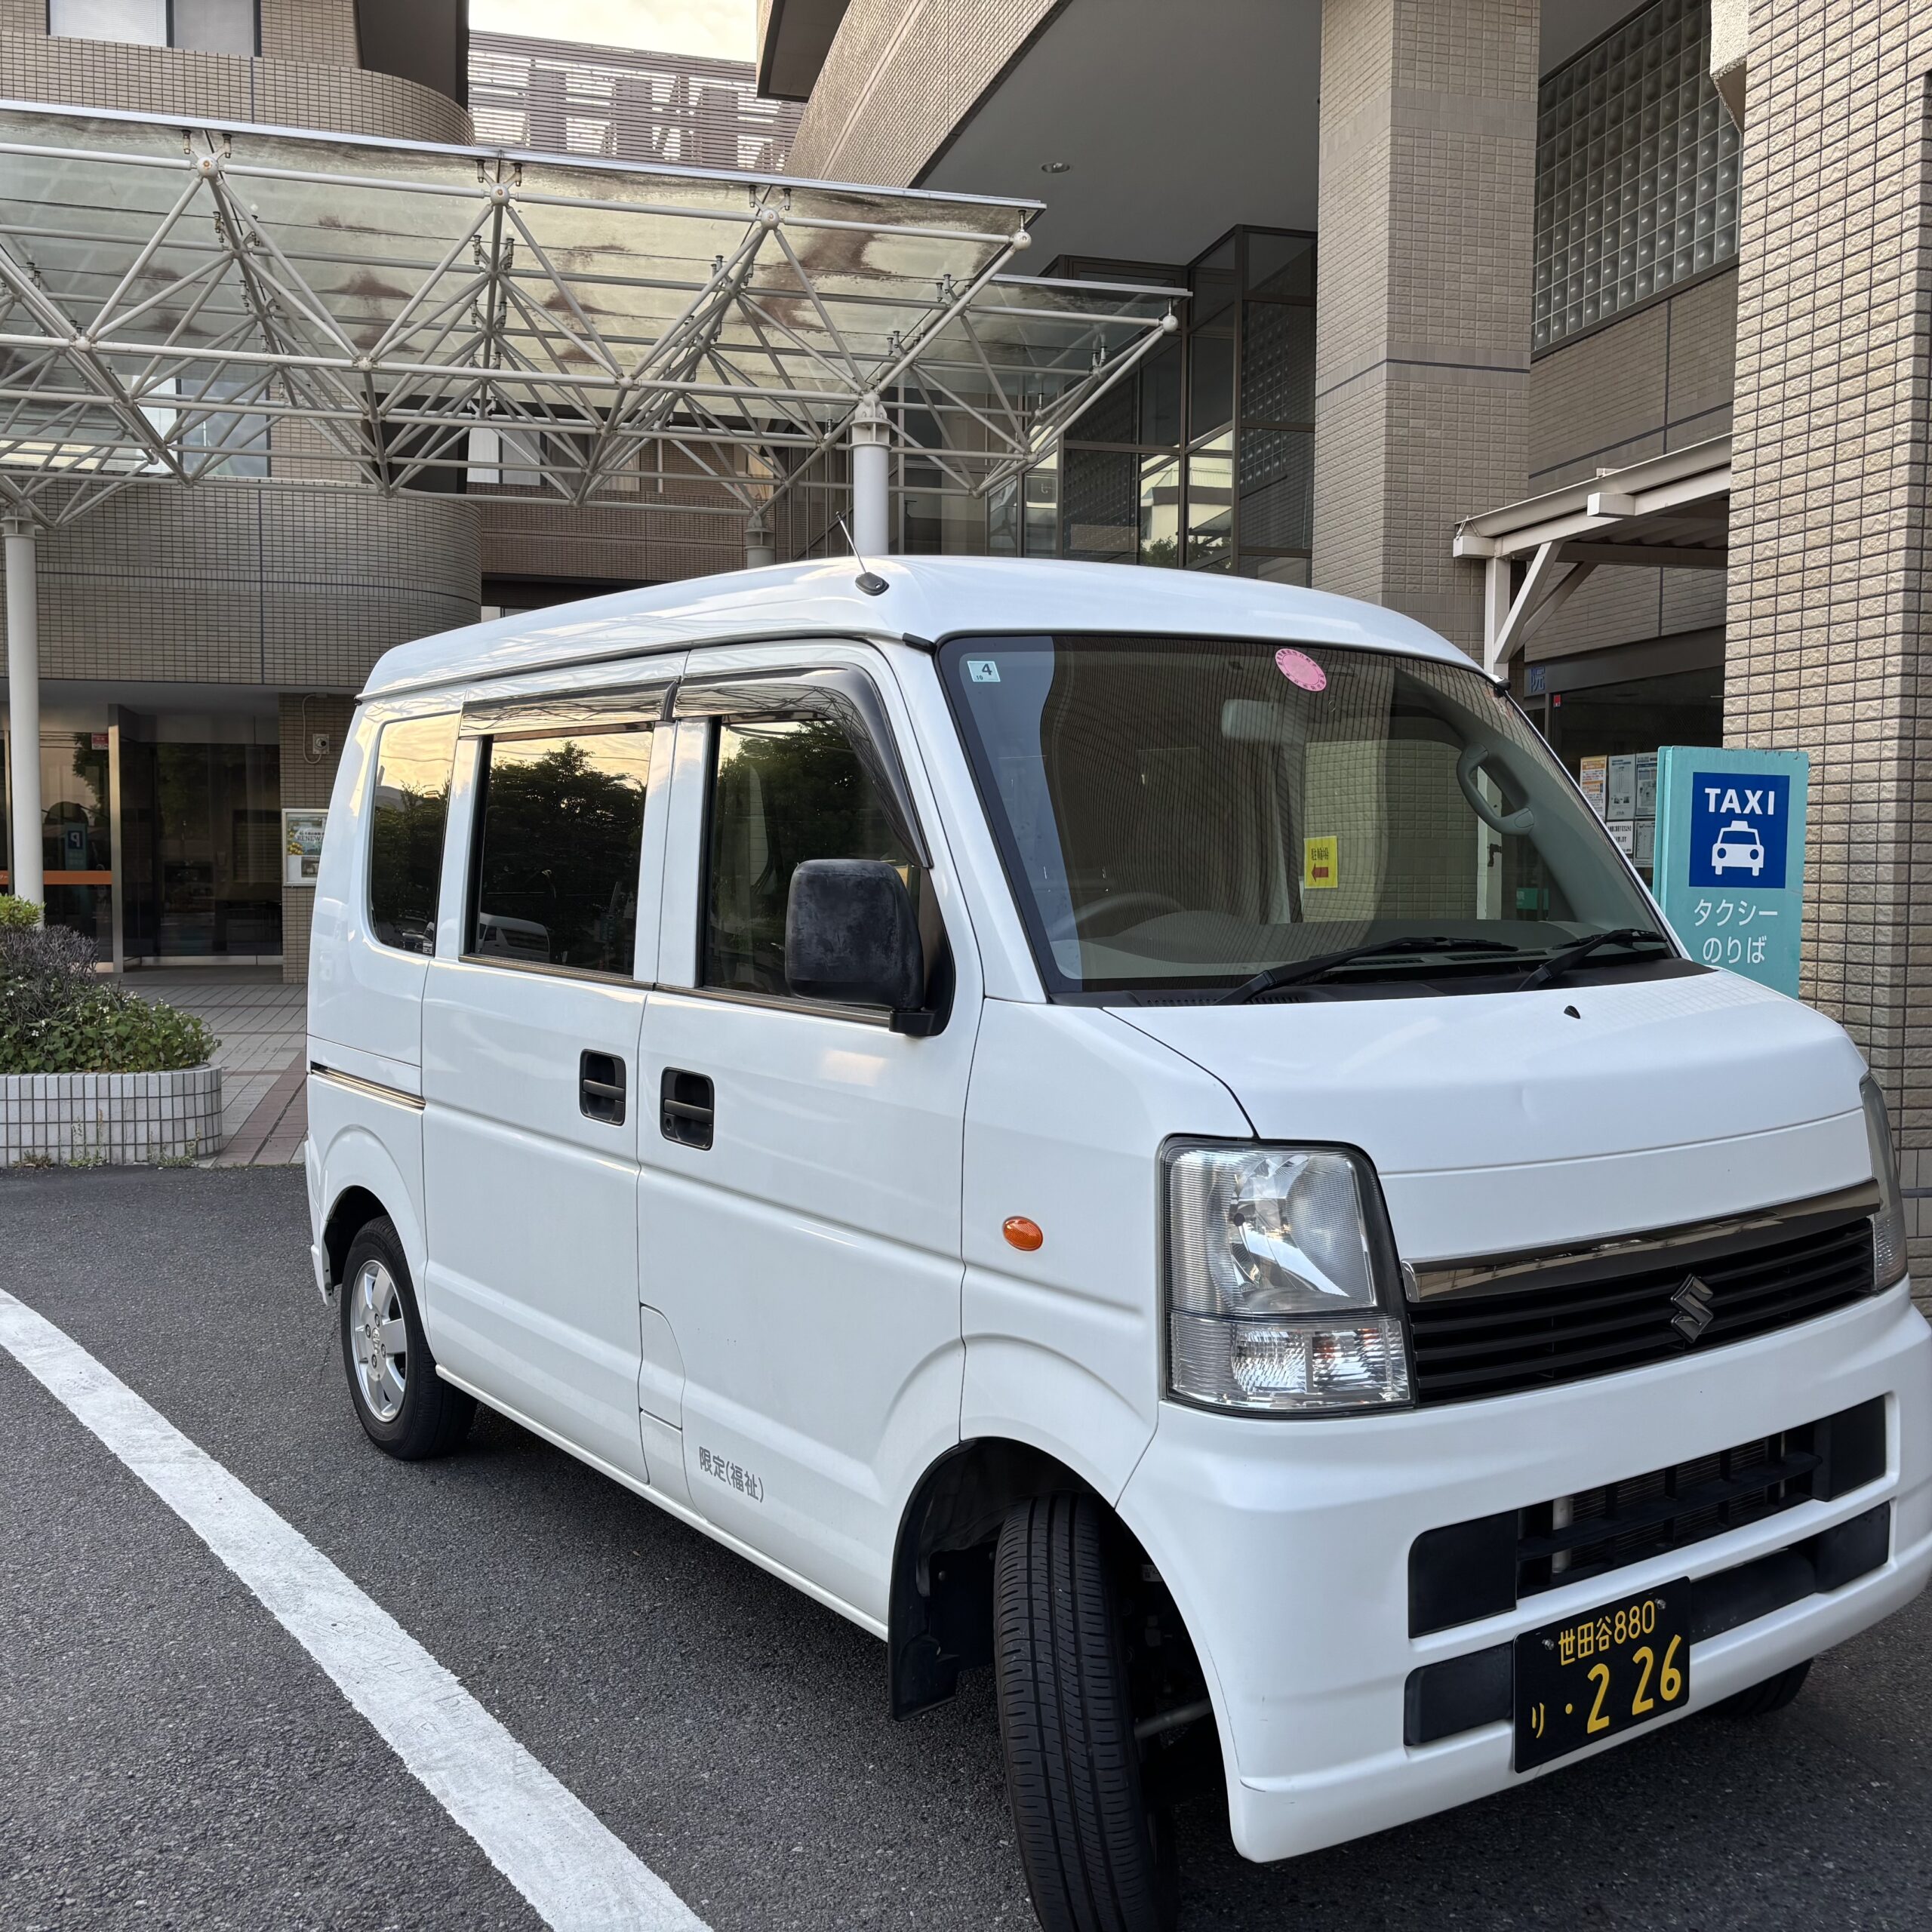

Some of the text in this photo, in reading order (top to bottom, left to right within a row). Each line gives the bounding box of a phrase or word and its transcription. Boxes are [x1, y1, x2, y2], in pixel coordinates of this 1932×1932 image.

[982, 663, 992, 675] 4
[1531, 666, 1546, 694] 院
[1704, 787, 1775, 816] TAXI
[1694, 899, 1778, 927] タクシー
[1702, 935, 1767, 964] のりば
[699, 1446, 764, 1503] 限定(福祉)
